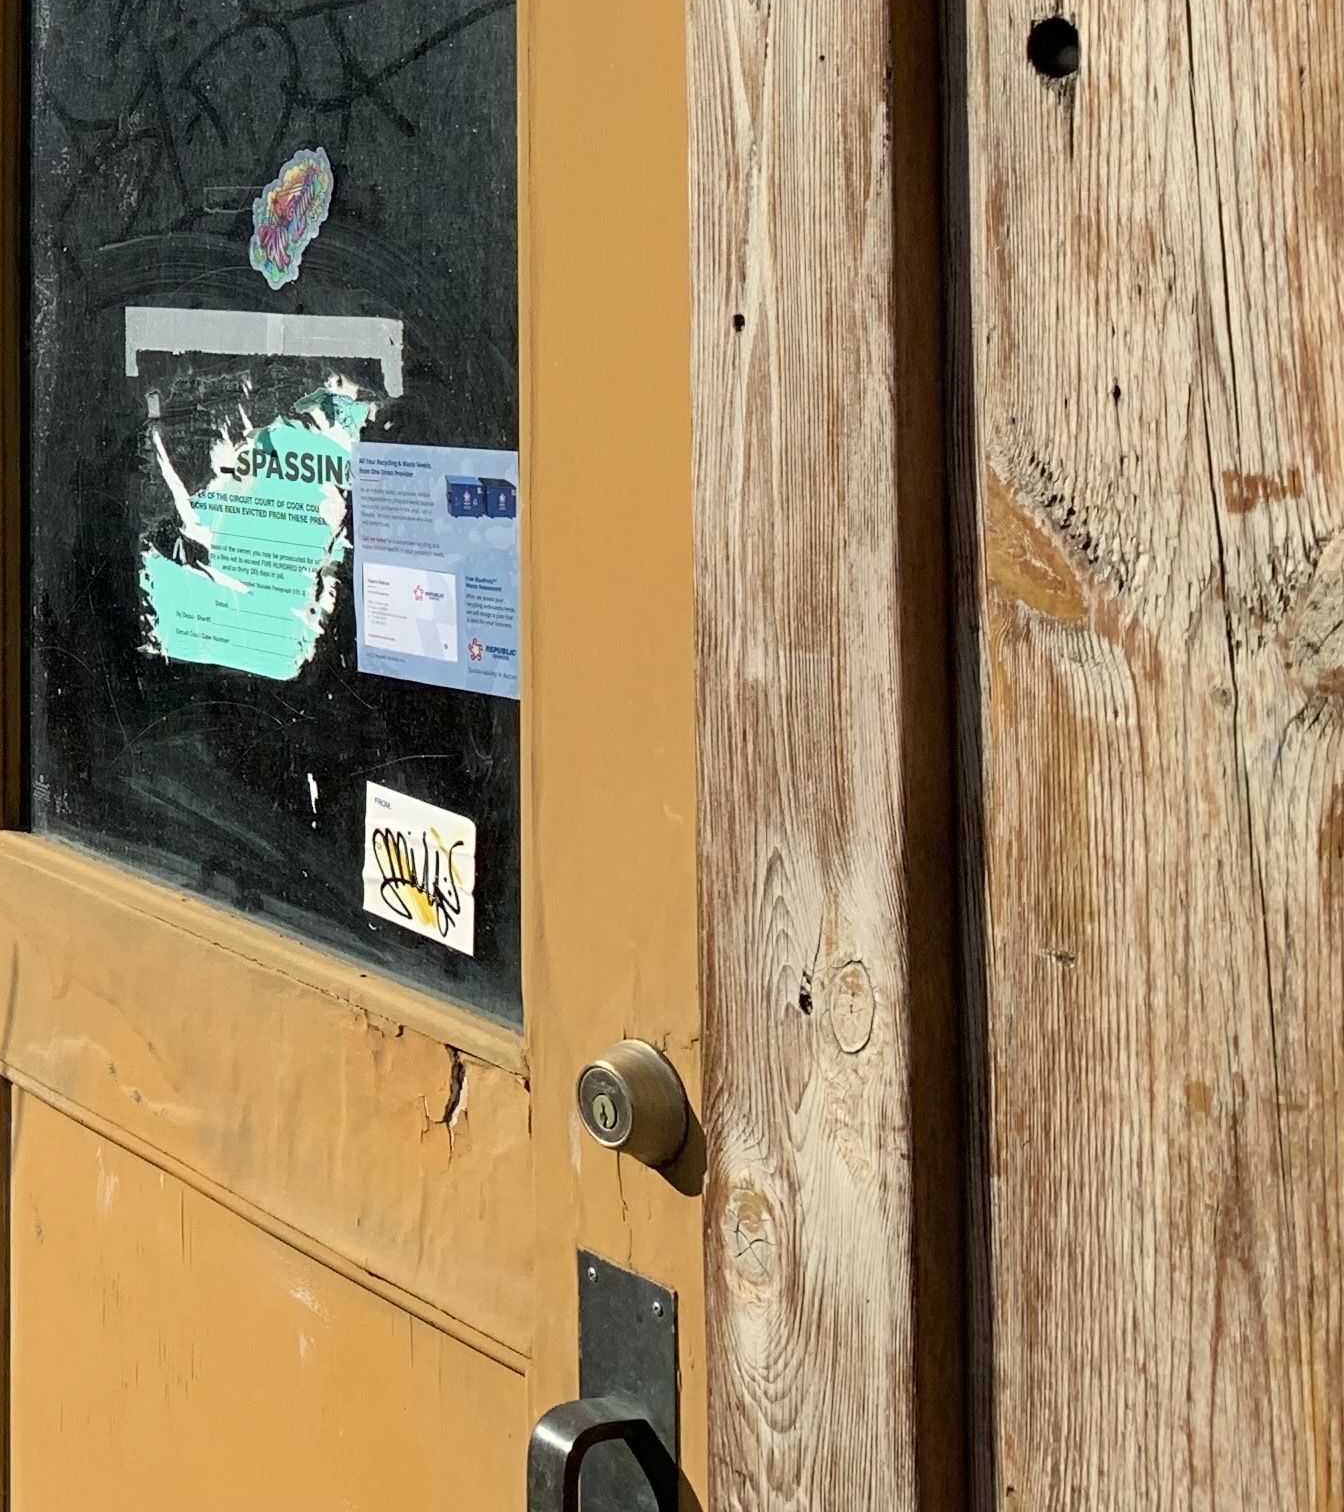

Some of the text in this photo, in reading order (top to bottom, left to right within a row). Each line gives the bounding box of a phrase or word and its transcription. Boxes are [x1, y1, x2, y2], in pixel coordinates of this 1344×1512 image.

[216, 493, 228, 502] THE
[229, 494, 253, 504] CIRCUIT
[254, 497, 275, 507] COURT
[286, 501, 304, 511] COOK
[208, 503, 223, 512] HAVE
[225, 505, 241, 514] BEEN
[242, 507, 267, 518] EVICTED
[269, 510, 287, 520] FROM
[288, 513, 308, 523] THESE
[485, 645, 517, 656] REPUBLIC
